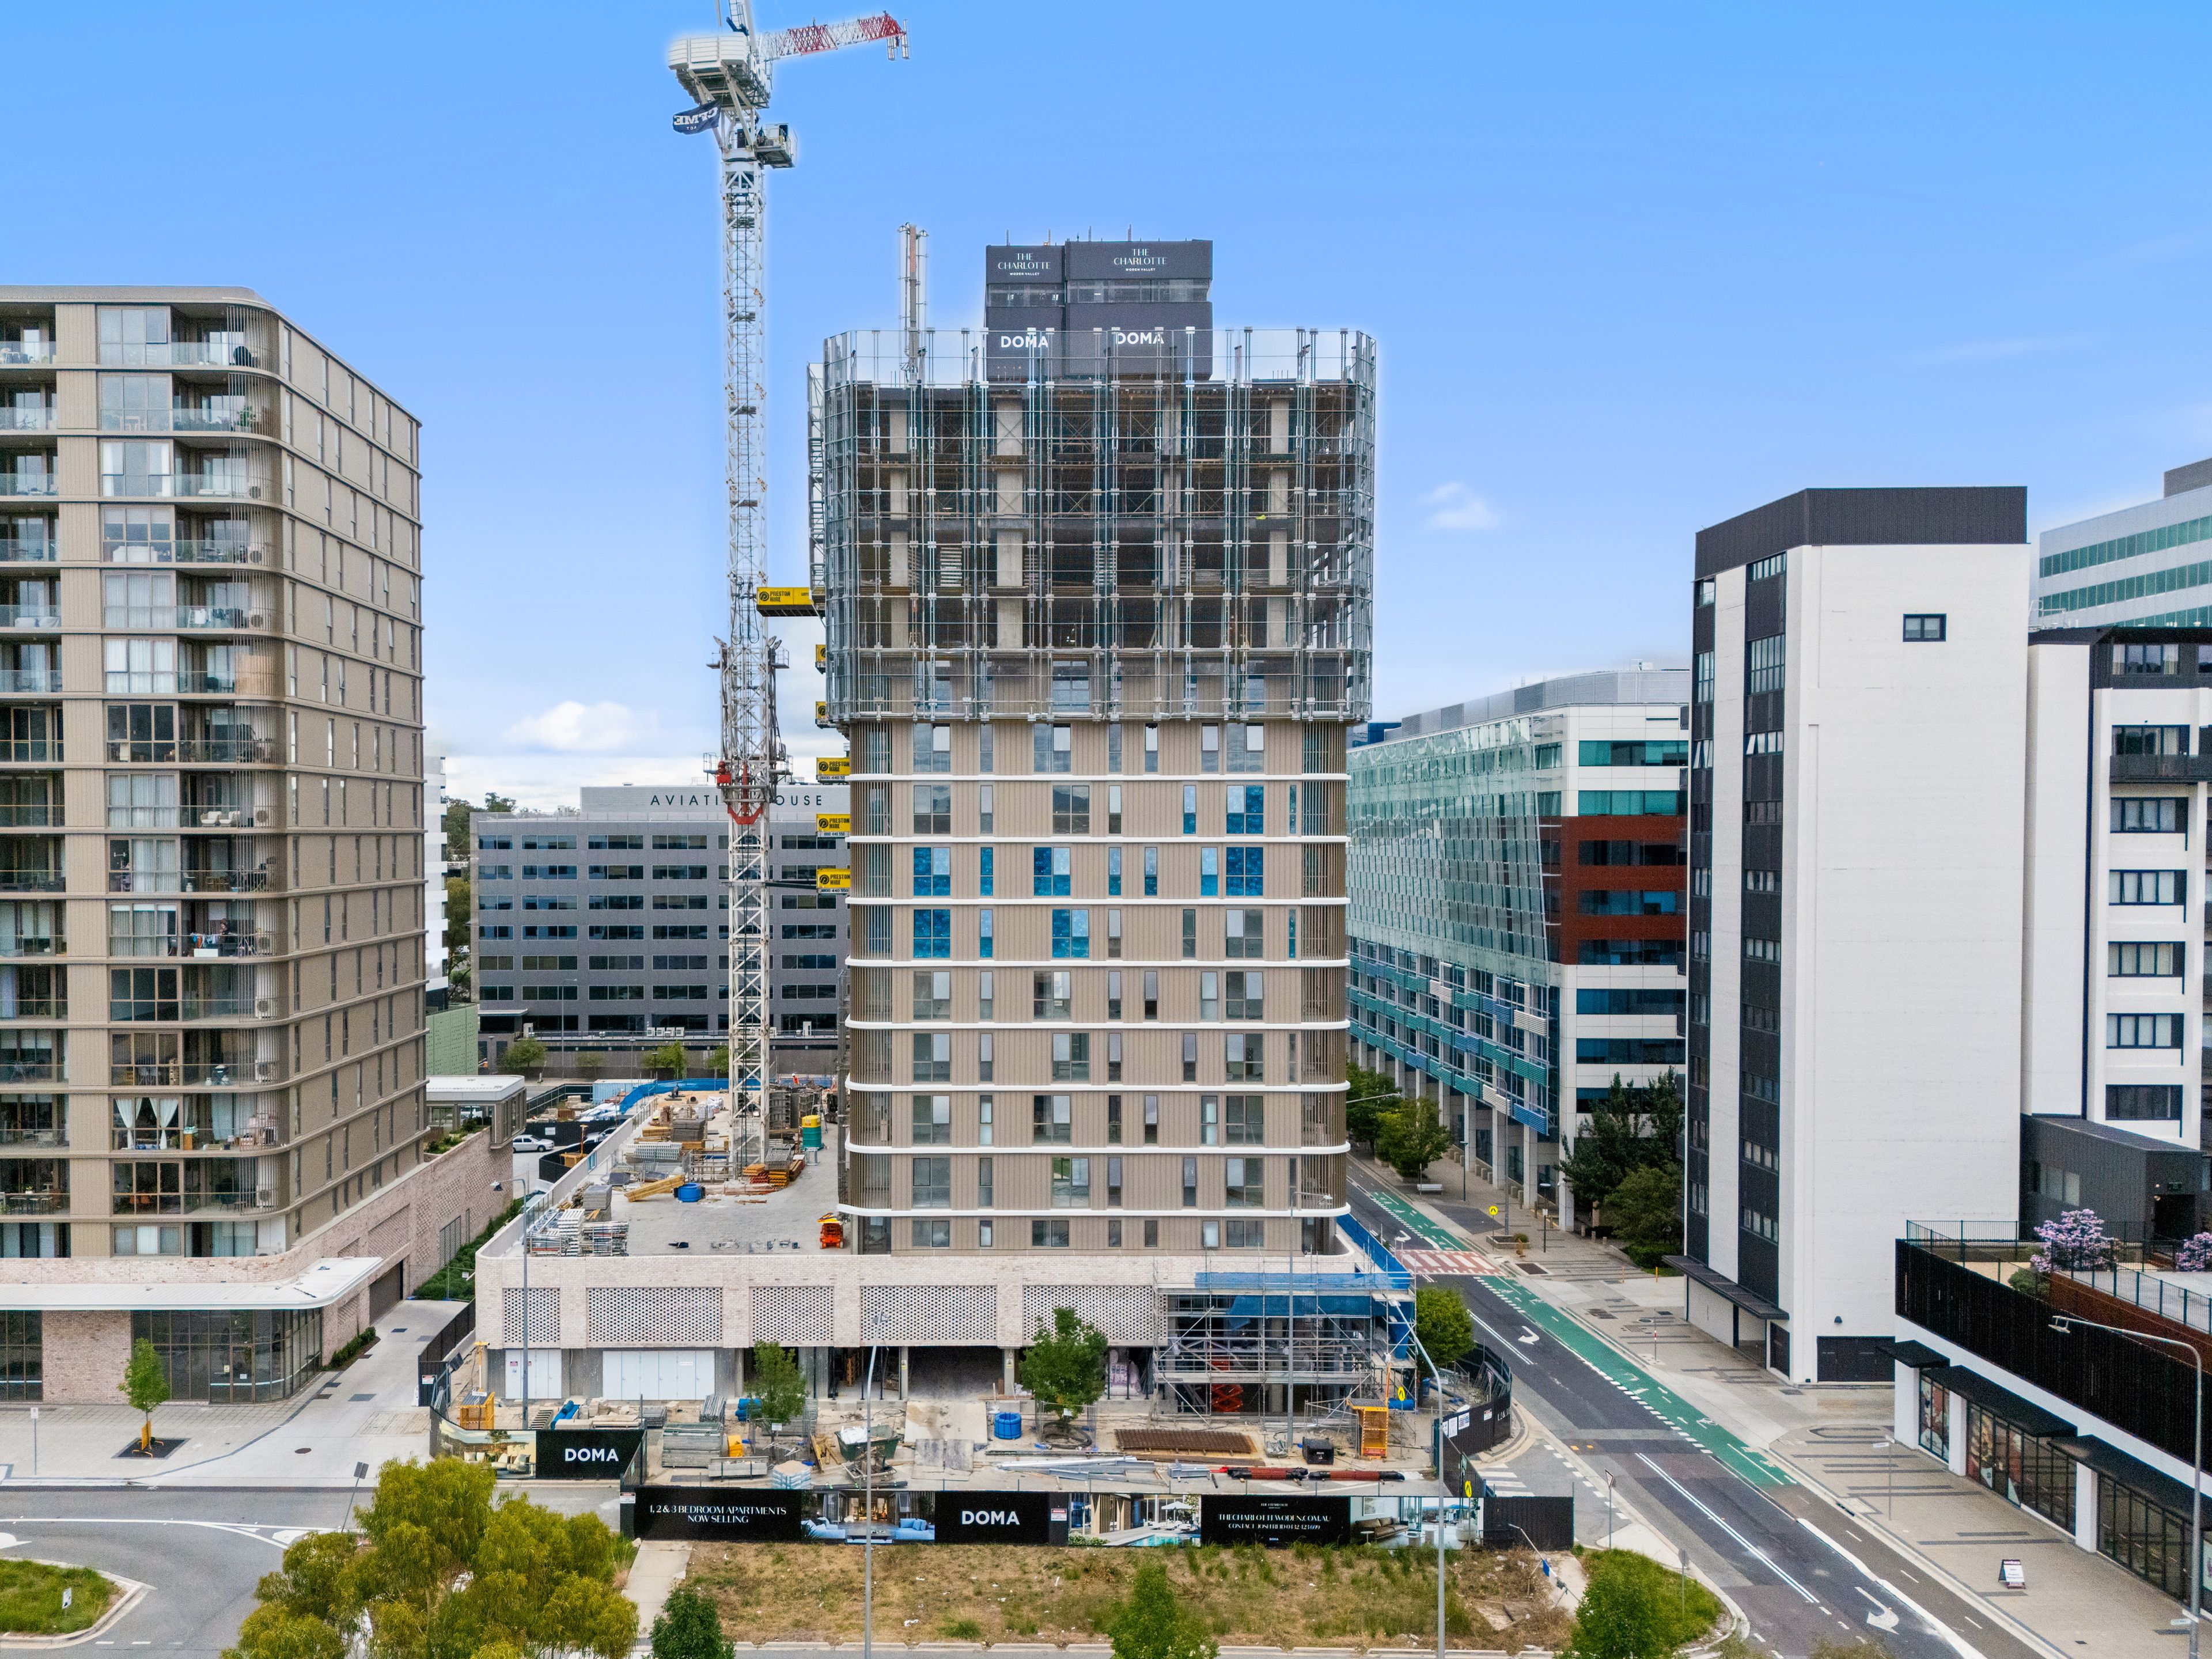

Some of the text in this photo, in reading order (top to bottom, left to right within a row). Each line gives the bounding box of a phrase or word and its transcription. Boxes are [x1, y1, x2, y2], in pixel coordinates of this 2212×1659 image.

[998, 262, 1051, 270] CHARLOTTE
[1113, 257, 1167, 265] CHARLOTTE
[1001, 336, 1048, 348] DOMA
[1116, 332, 1164, 344] DOMA
[650, 795, 822, 805] AVIATI OUSE
[565, 1448, 619, 1461] DOMA
[650, 1505, 787, 1515] 1, 2 & 3 BEDROOM APARTMENTS
[688, 1514, 749, 1524] NOW SELLING
[961, 1510, 1020, 1525] DOMA
